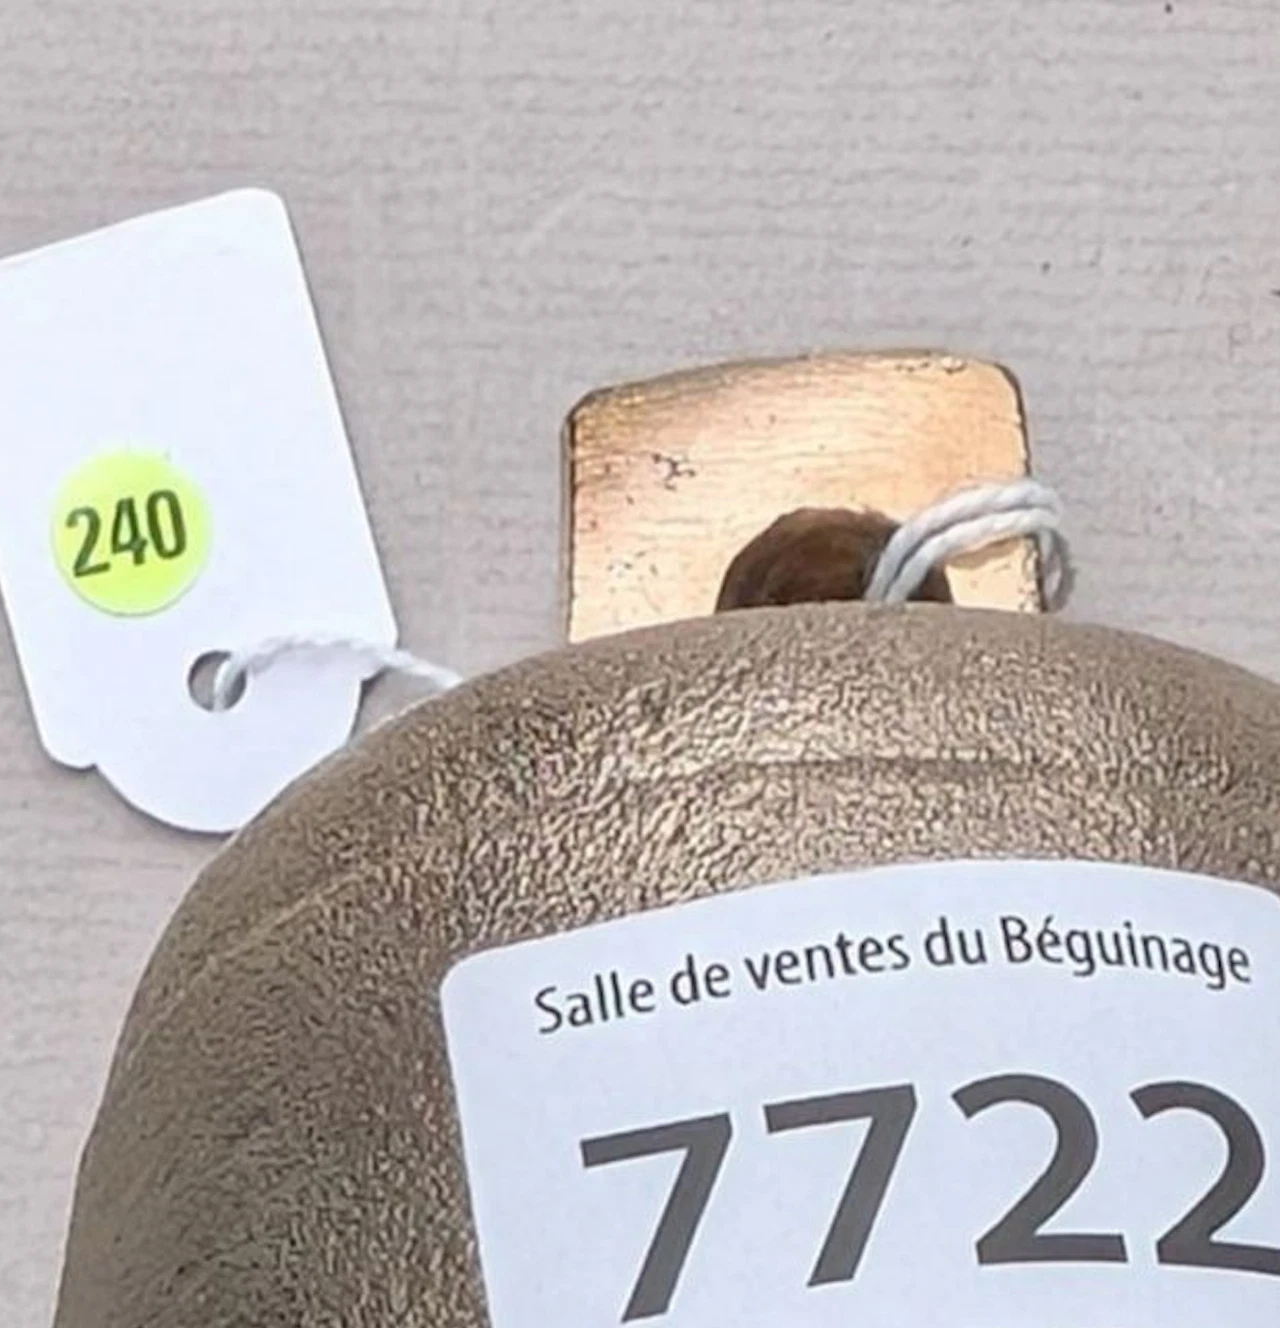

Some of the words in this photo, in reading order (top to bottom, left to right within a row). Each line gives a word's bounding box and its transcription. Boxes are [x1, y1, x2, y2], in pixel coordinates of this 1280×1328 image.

[66, 489, 187, 578] 240
[534, 971, 655, 1035] Salle
[670, 953, 731, 1006] de
[743, 932, 911, 986] ventes
[924, 916, 988, 967] du
[1002, 915, 1251, 990] Béguinage
